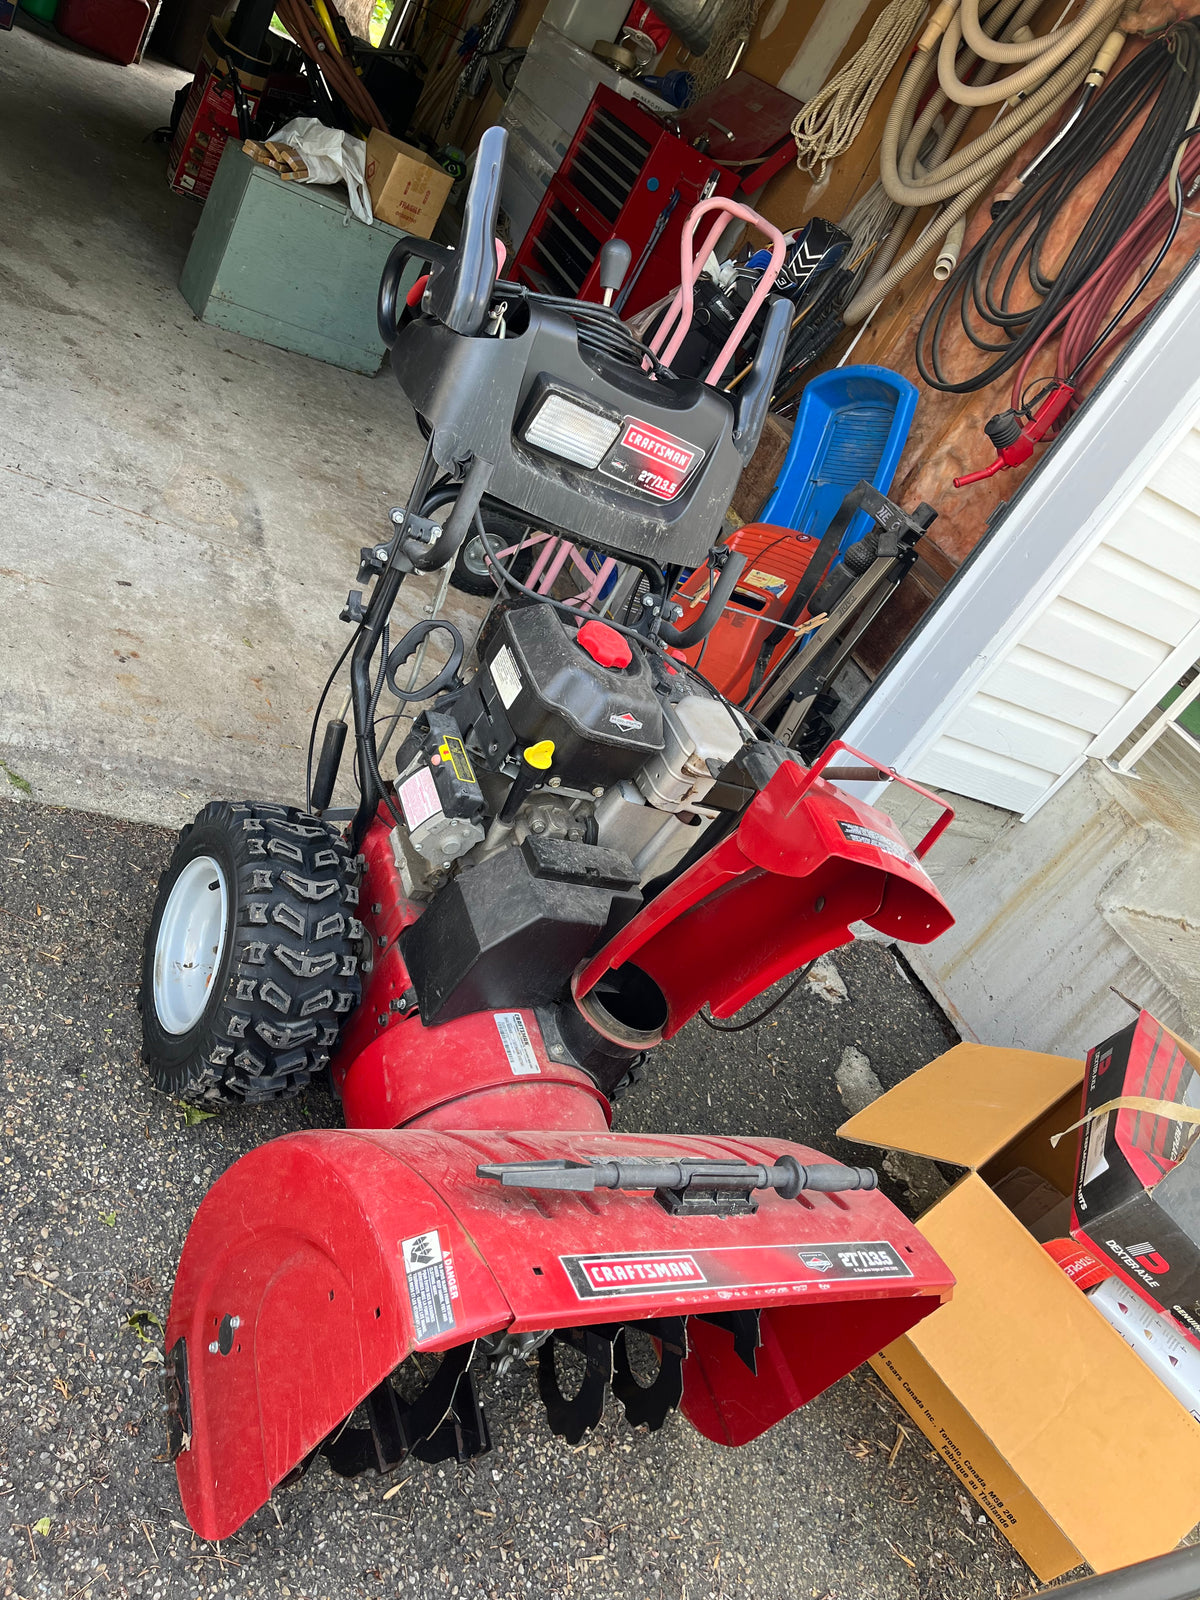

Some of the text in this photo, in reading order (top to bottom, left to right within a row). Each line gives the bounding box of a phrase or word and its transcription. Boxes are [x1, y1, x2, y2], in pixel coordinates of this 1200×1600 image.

[628, 431, 689, 467] CRAFTSMAN
[514, 1013, 530, 1046] CRAFTSMAN
[1077, 1183, 1088, 1210] PARTS
[444, 1259, 459, 1300] DANGER
[590, 1261, 695, 1283] CRAFTSMAN
[1064, 1256, 1096, 1277] STAPLE
[1105, 1239, 1160, 1288] DEXTER AXLE
[885, 1360, 903, 1382] Sears
[902, 1381, 924, 1409] Canada
[939, 1428, 962, 1459] Toronto,
[941, 1445, 969, 1479] Fabrique
[968, 1479, 979, 1490] au
